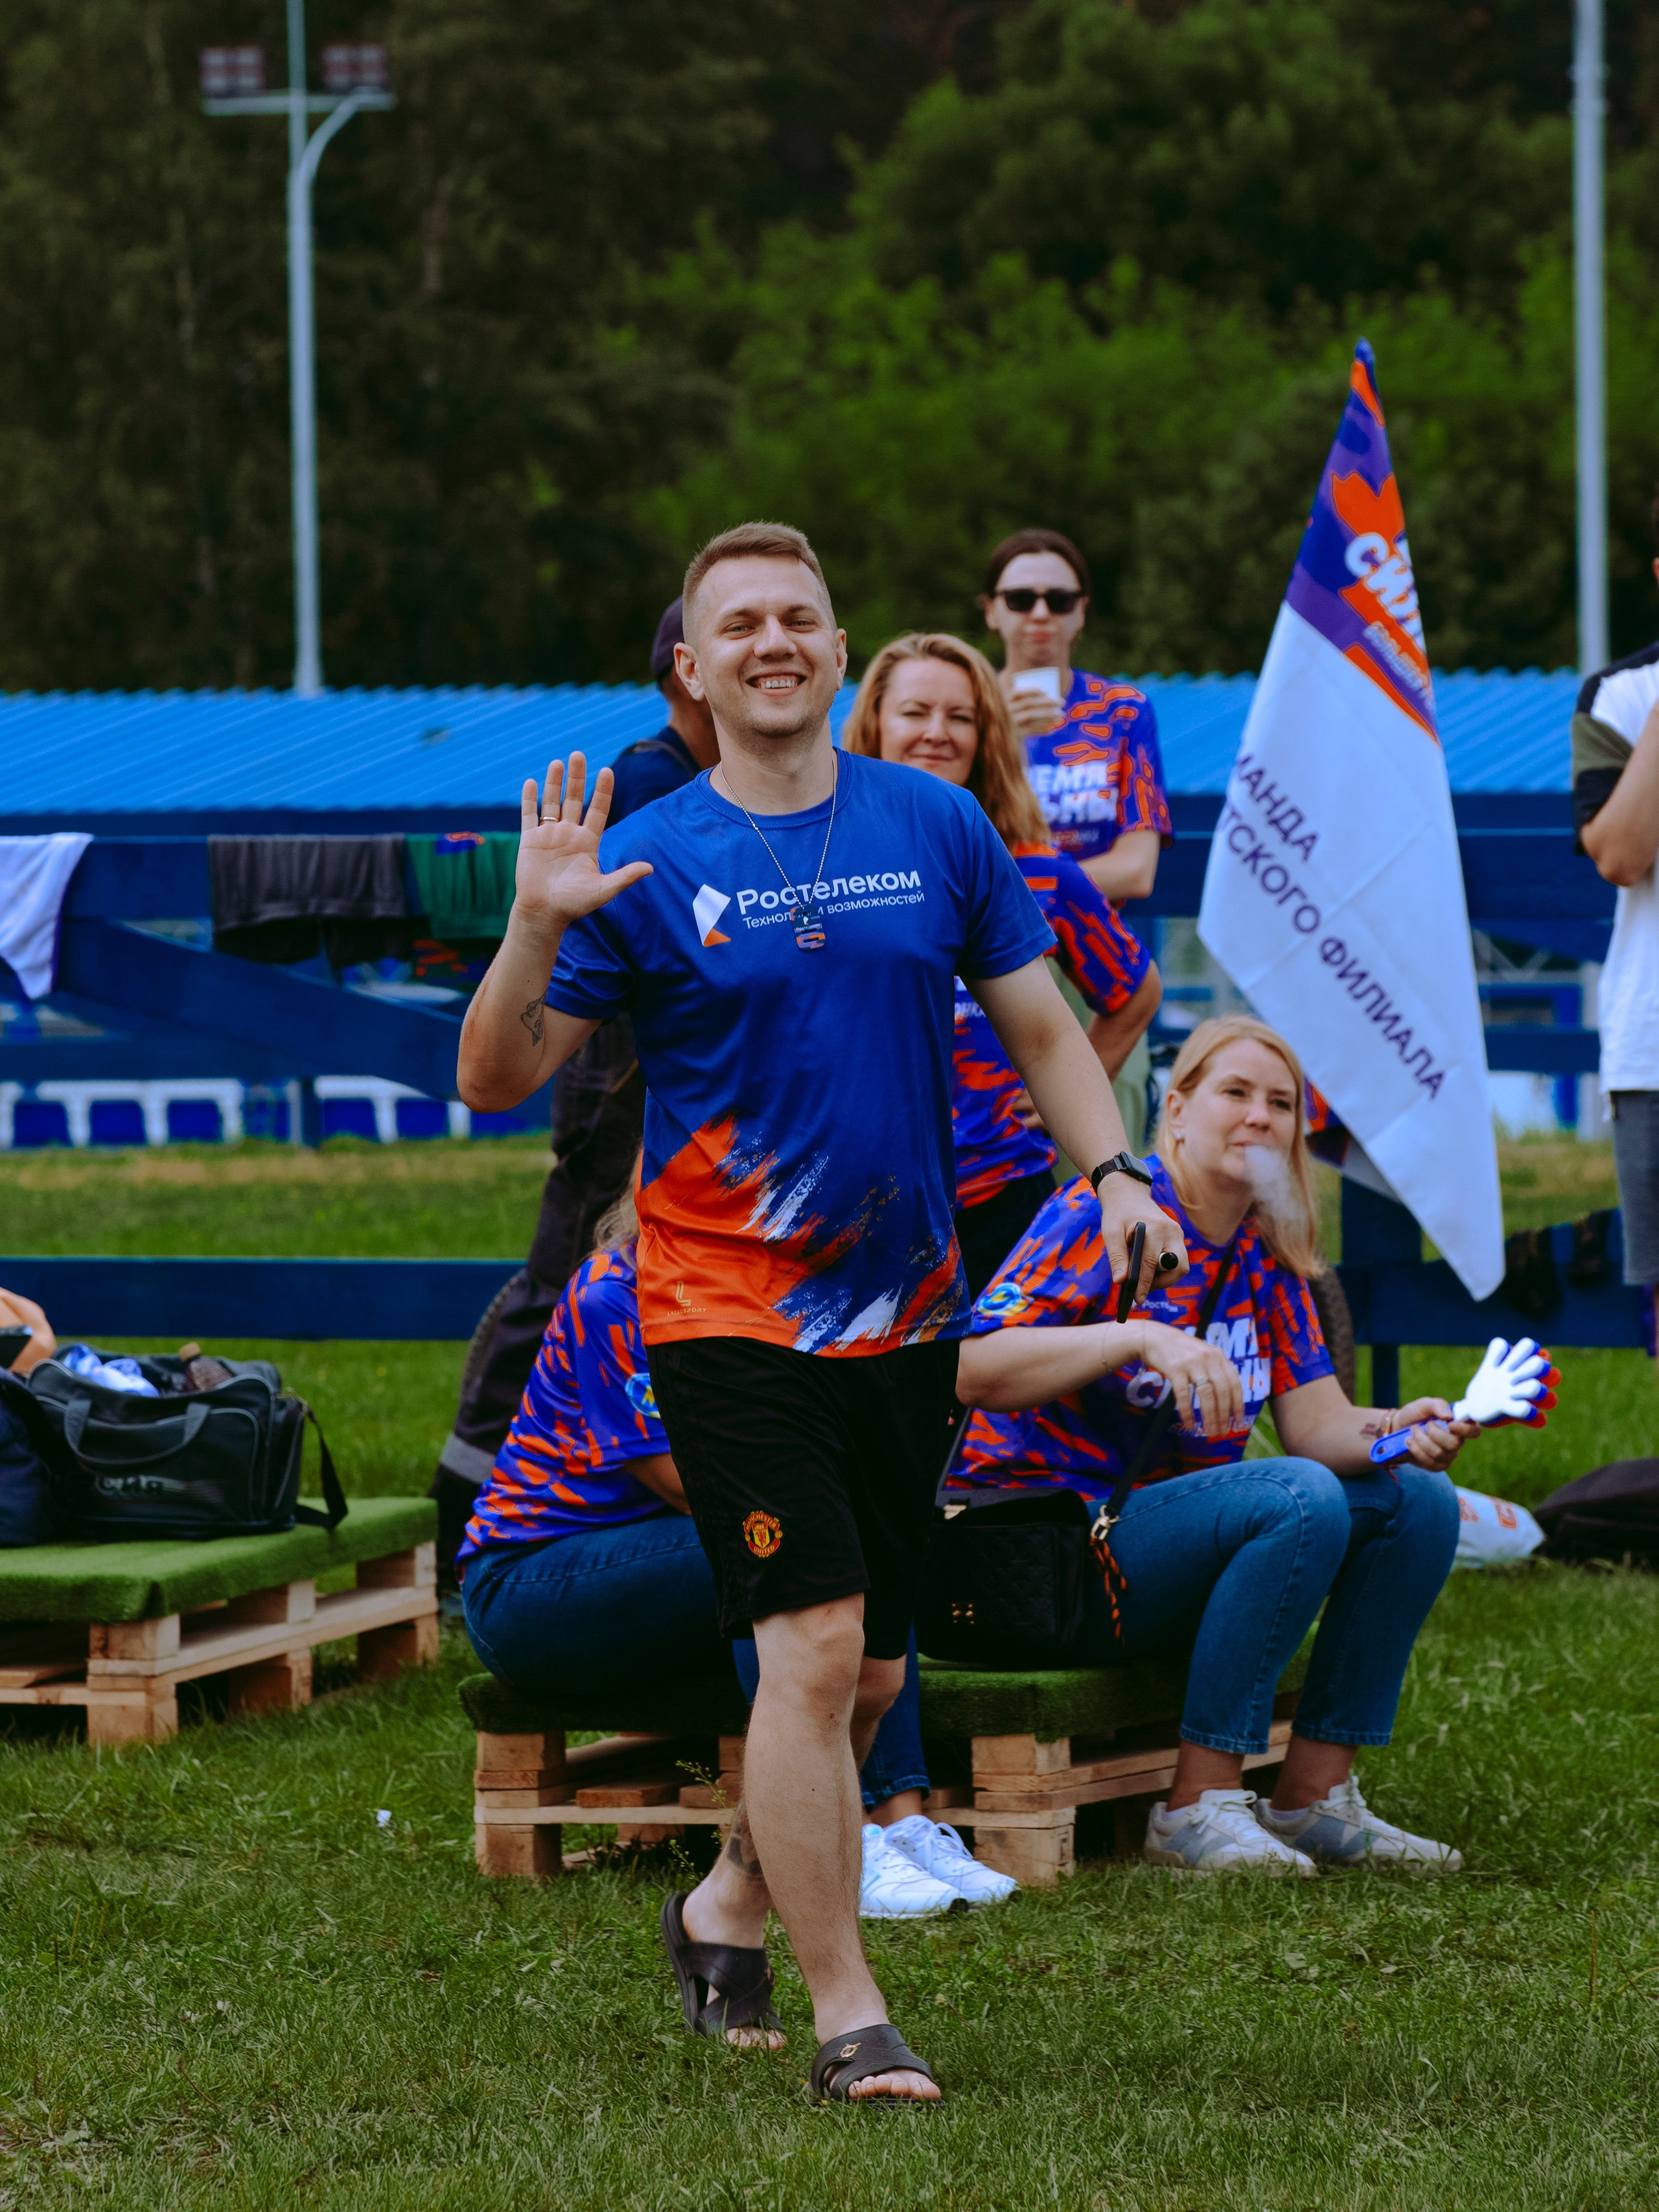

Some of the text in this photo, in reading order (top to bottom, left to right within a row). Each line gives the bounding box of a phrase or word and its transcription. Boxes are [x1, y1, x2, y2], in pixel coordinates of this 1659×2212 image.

[736, 870, 922, 915] Ростелеком
[827, 890, 925, 914] возможностей
[1319, 937, 1445, 1100] ФИЛИАЛА
[745, 1513, 777, 1530] MANCHESTER
[753, 1544, 775, 1555] UNITED
